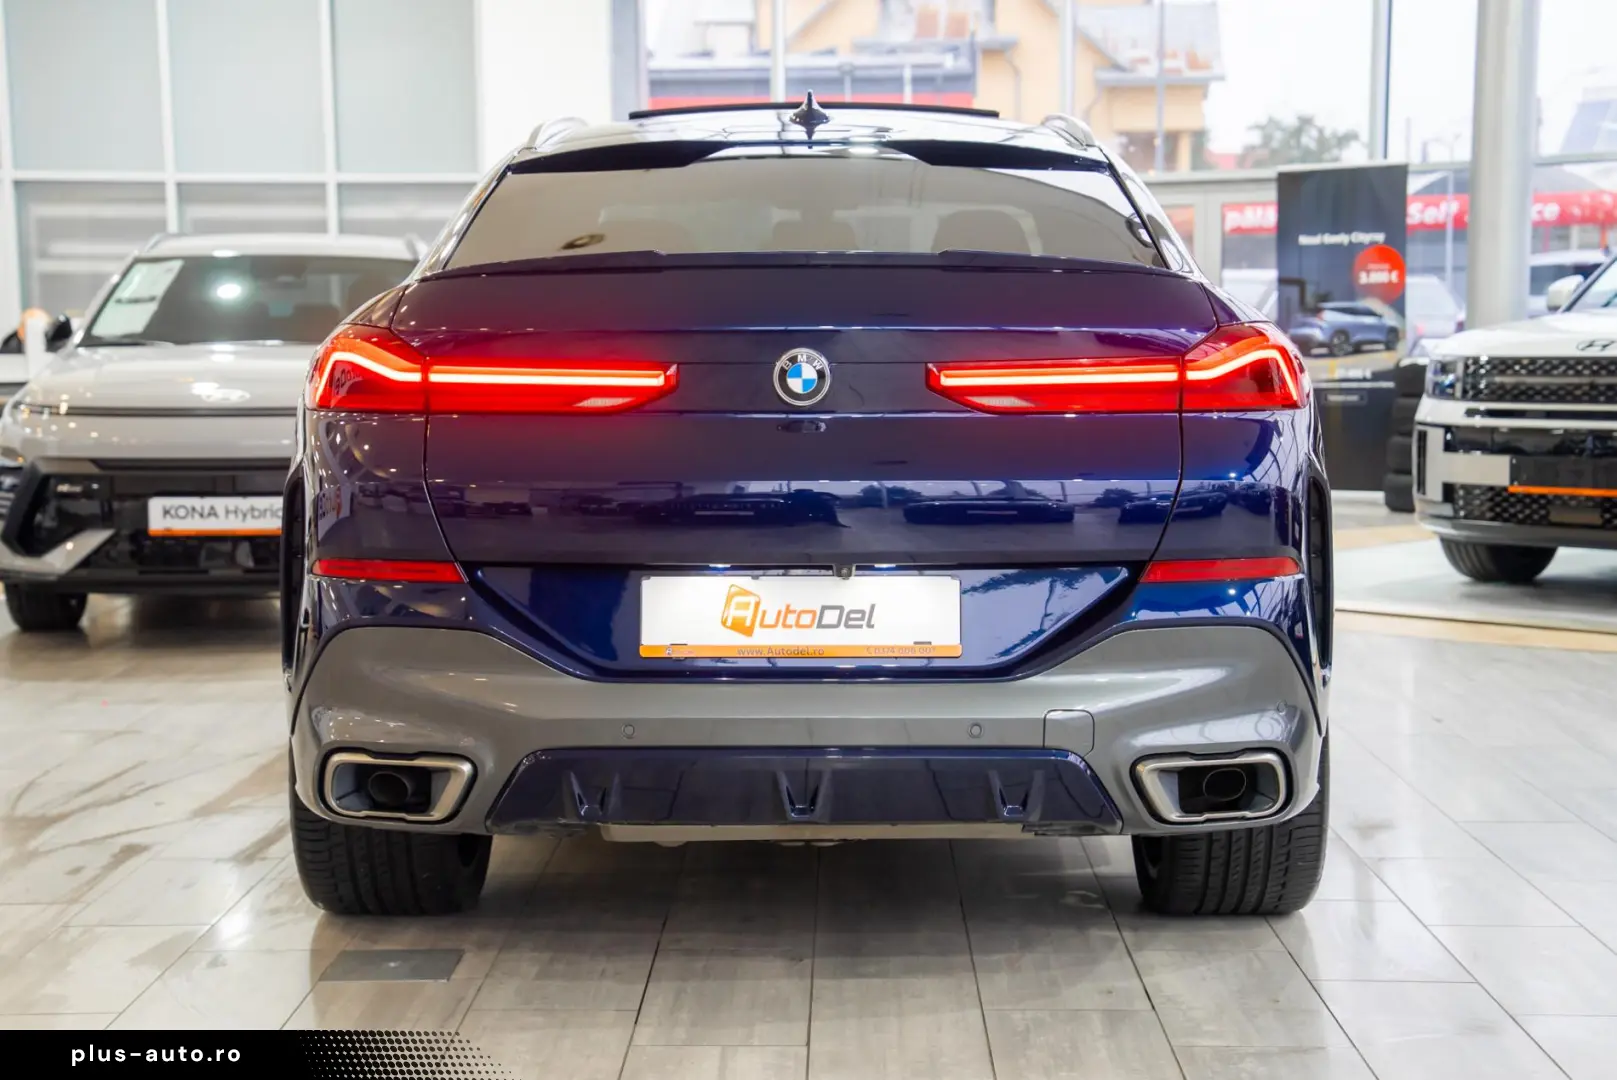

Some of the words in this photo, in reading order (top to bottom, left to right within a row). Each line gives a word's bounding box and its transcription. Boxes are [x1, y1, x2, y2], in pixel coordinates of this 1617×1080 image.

[782, 354, 823, 370] BMW
[162, 504, 219, 519] KONA
[721, 584, 875, 637] AutoDel
[736, 646, 825, 657] www.Autodel.ro
